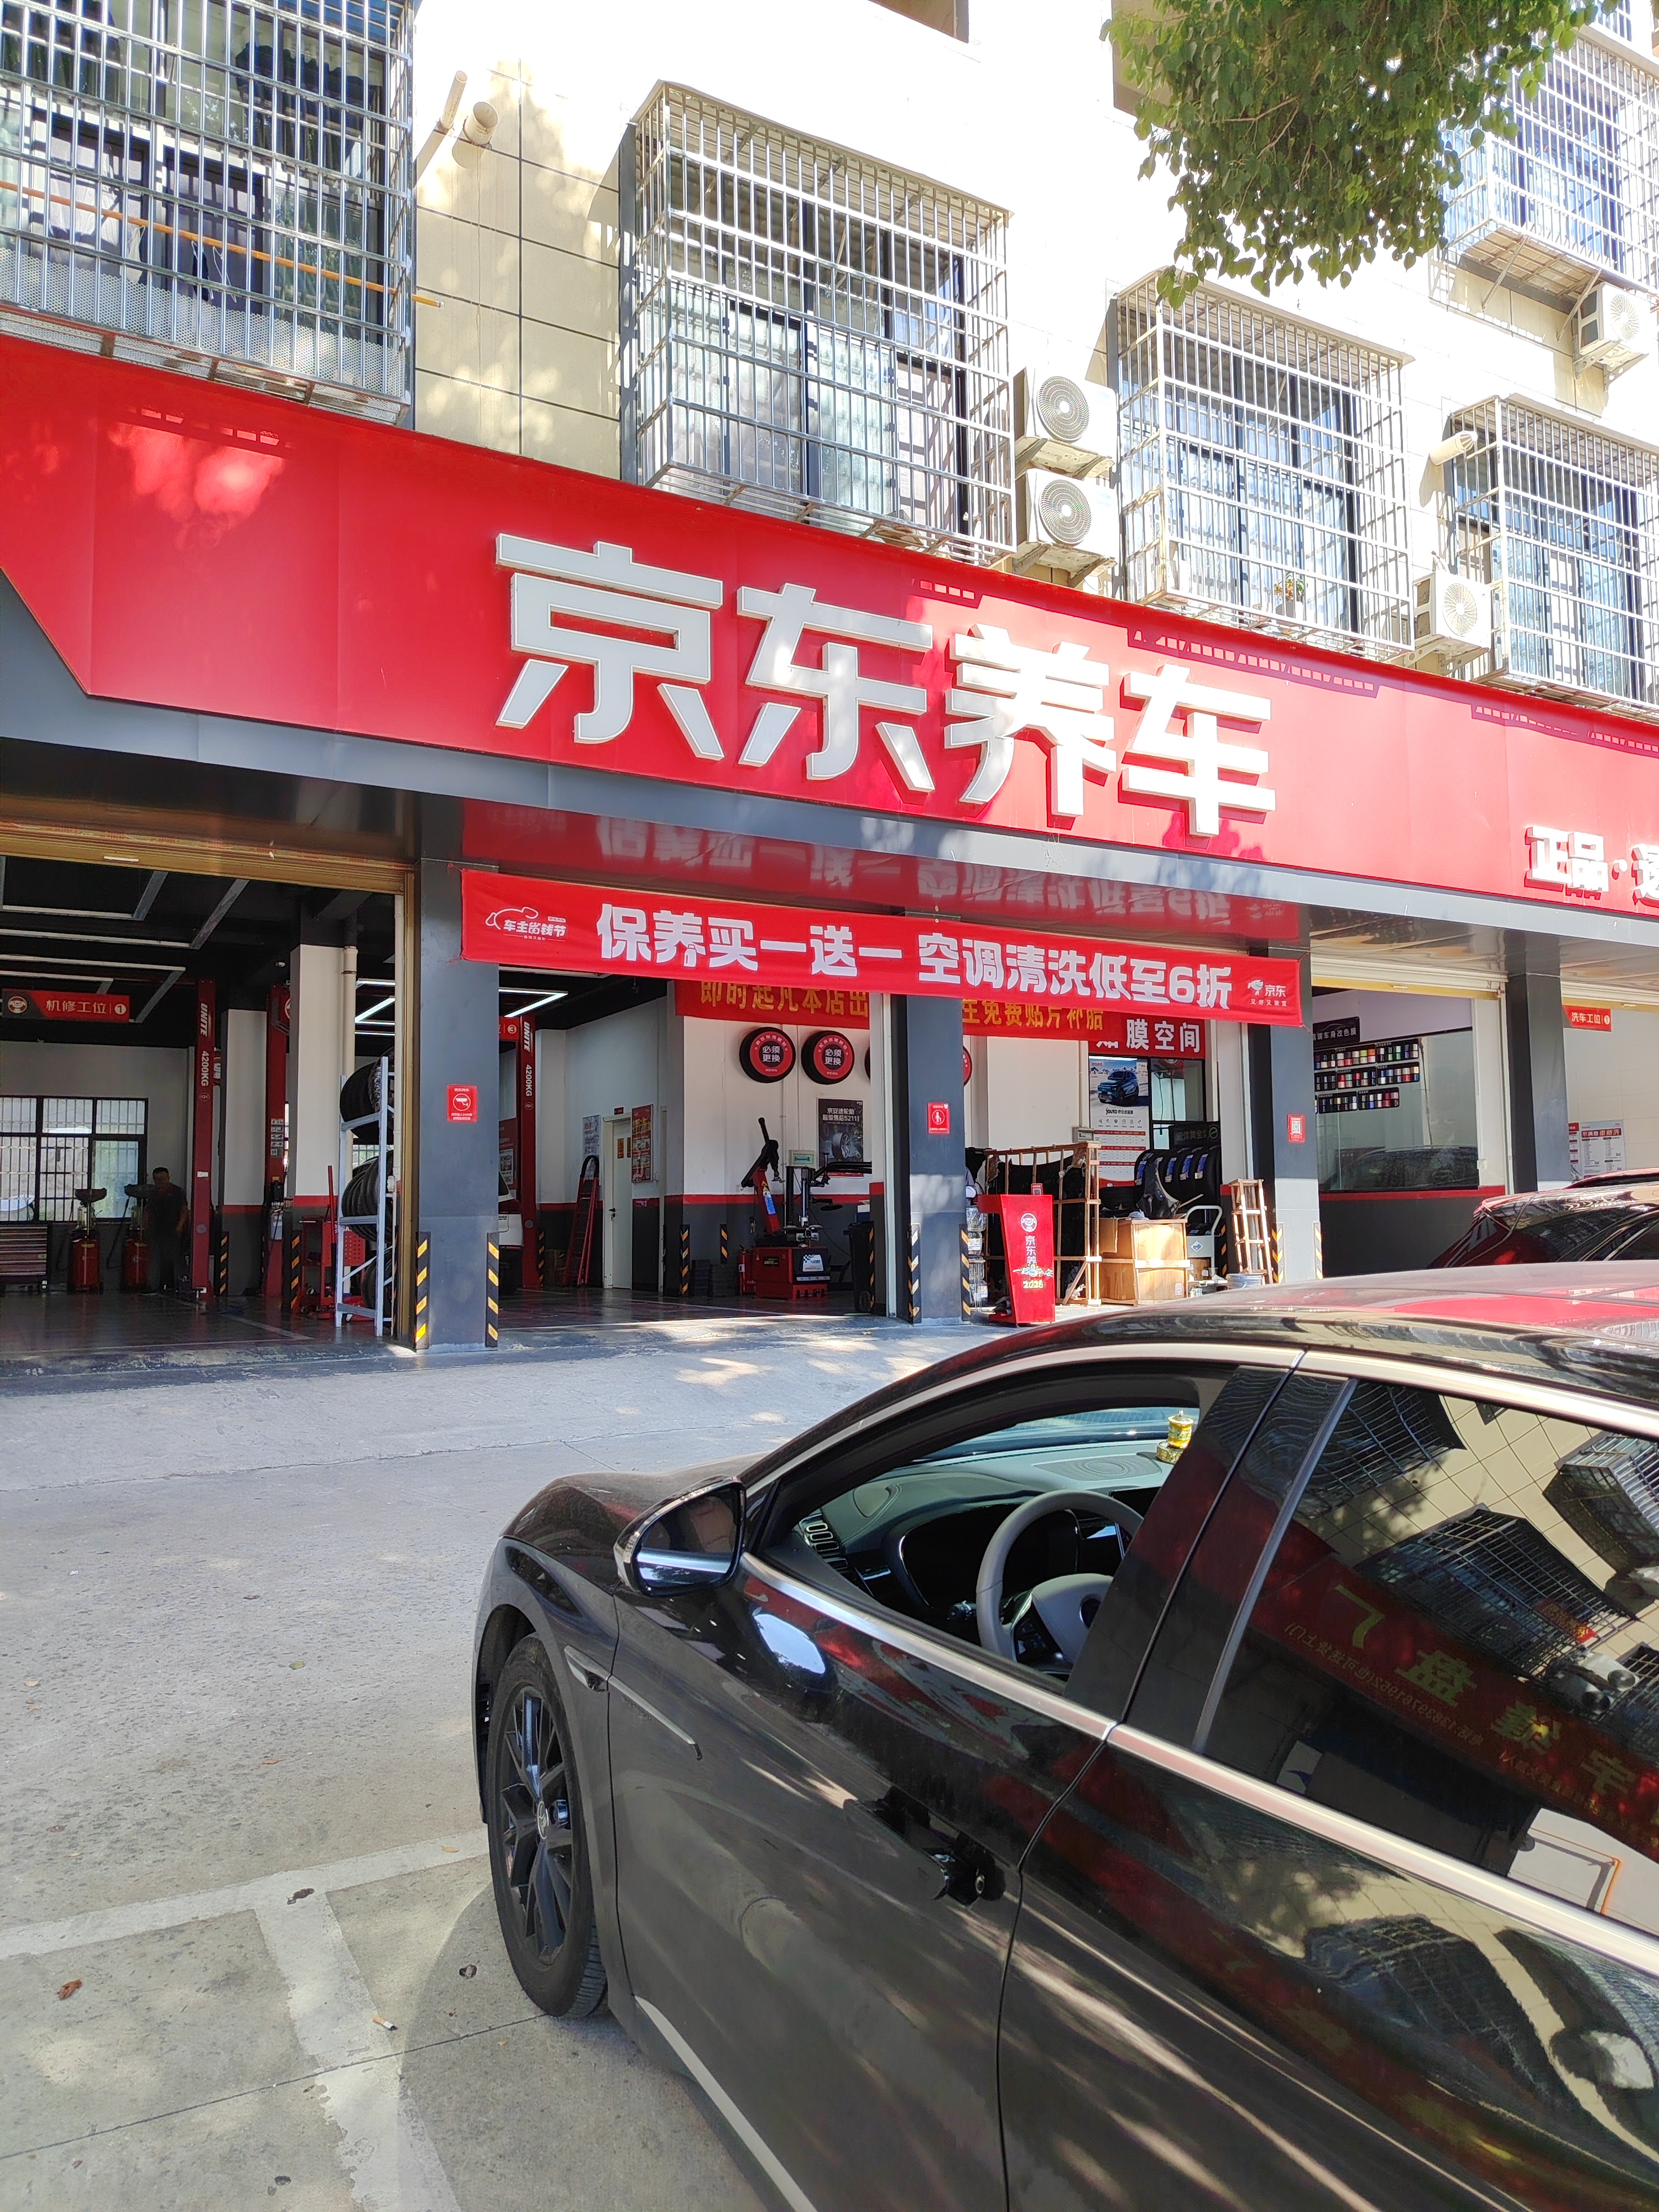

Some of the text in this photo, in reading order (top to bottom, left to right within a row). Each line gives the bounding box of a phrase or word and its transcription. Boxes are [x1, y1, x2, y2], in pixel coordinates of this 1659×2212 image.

[495, 534, 1276, 837] 京东养车
[503, 920, 566, 937] 车主省钱节
[597, 903, 1233, 1009] 保养买一送一 空调清洗低至6折
[1264, 984, 1286, 997] 京东
[46, 999, 107, 1014] 机修工位
[200, 1003, 209, 1037] UNITE
[1572, 1011, 1601, 1024] 洗车工位
[1097, 1019, 1200, 1053] 膜空间
[762, 1045, 781, 1053] 必须
[825, 1048, 842, 1057] 必须
[762, 1054, 781, 1062] 更换
[825, 1056, 842, 1066] 更换
[201, 1050, 210, 1087] 4200KG
[1022, 1279, 1044, 1288] 2026
